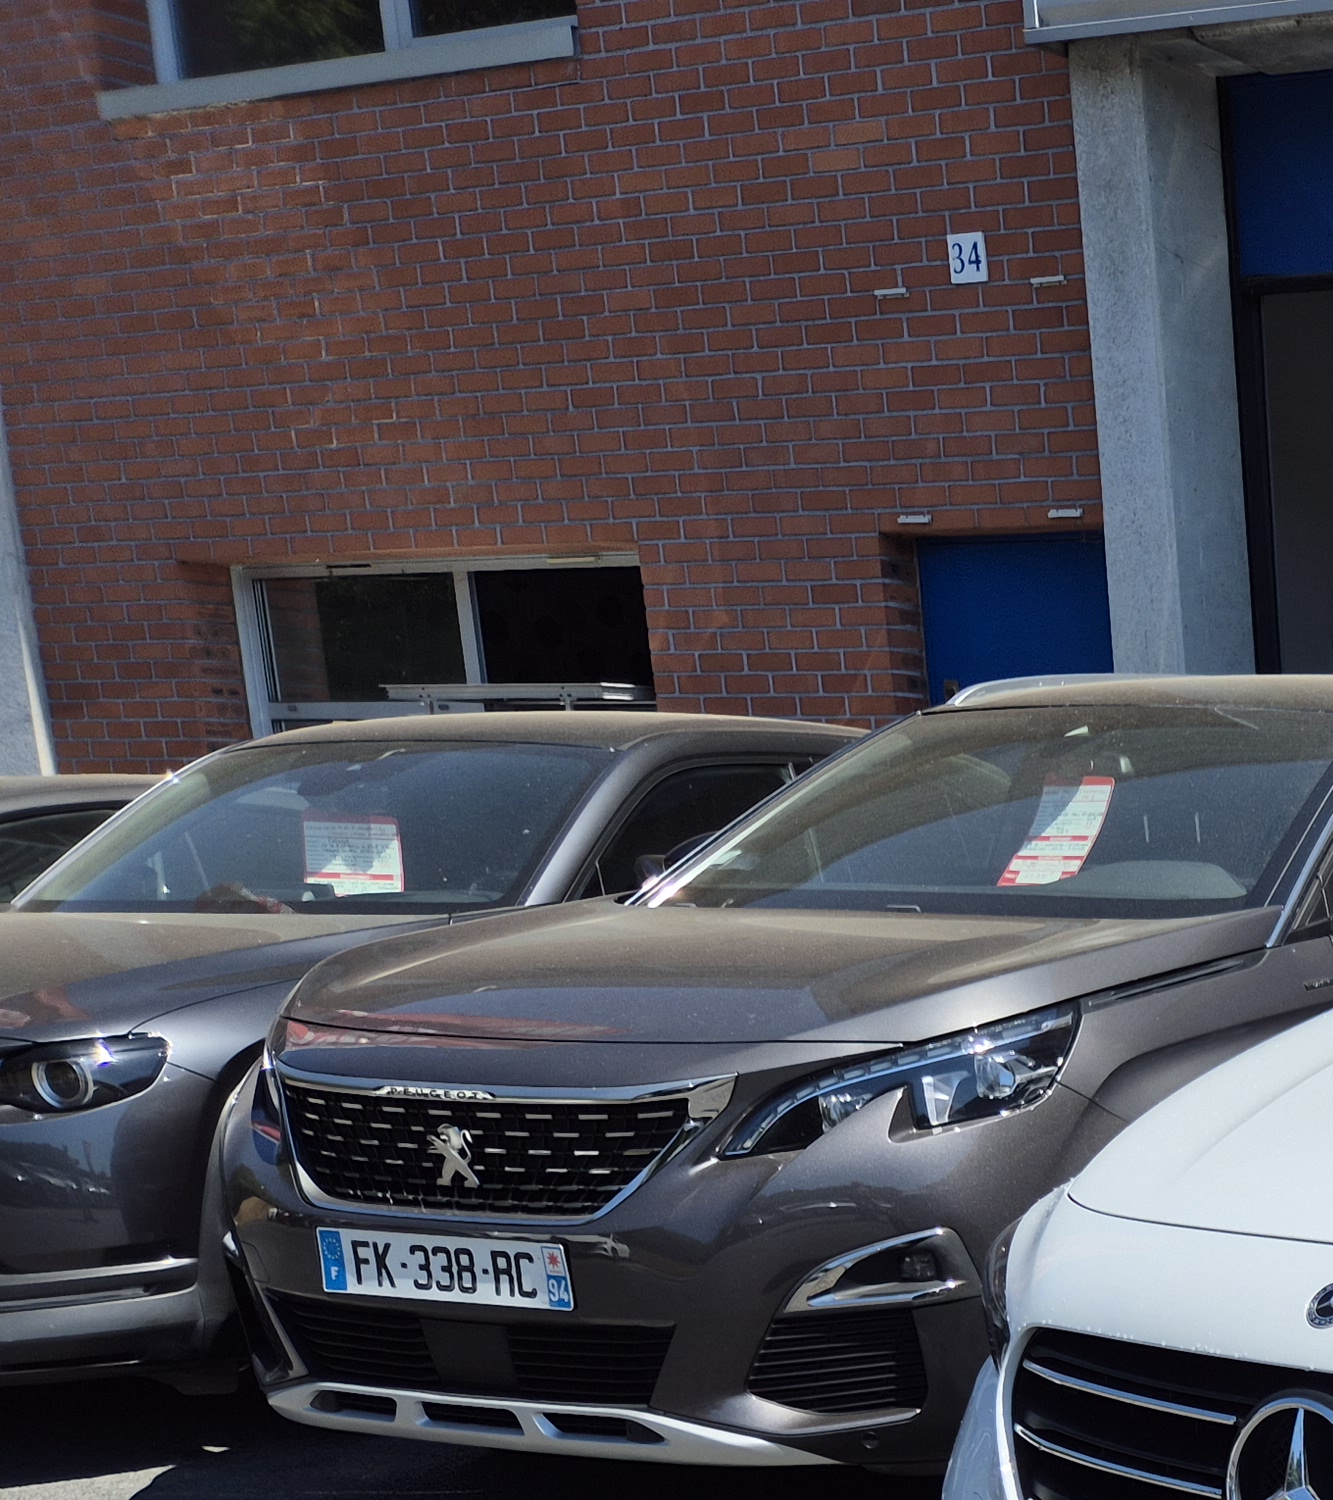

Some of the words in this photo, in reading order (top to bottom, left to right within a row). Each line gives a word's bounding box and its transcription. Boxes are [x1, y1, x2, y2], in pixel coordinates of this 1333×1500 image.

[952, 241, 982, 274] 34
[388, 1086, 484, 1100] PEUGEOT
[330, 1265, 339, 1281] F
[351, 1240, 538, 1299] FK-338-RC
[548, 1278, 569, 1303] 94
